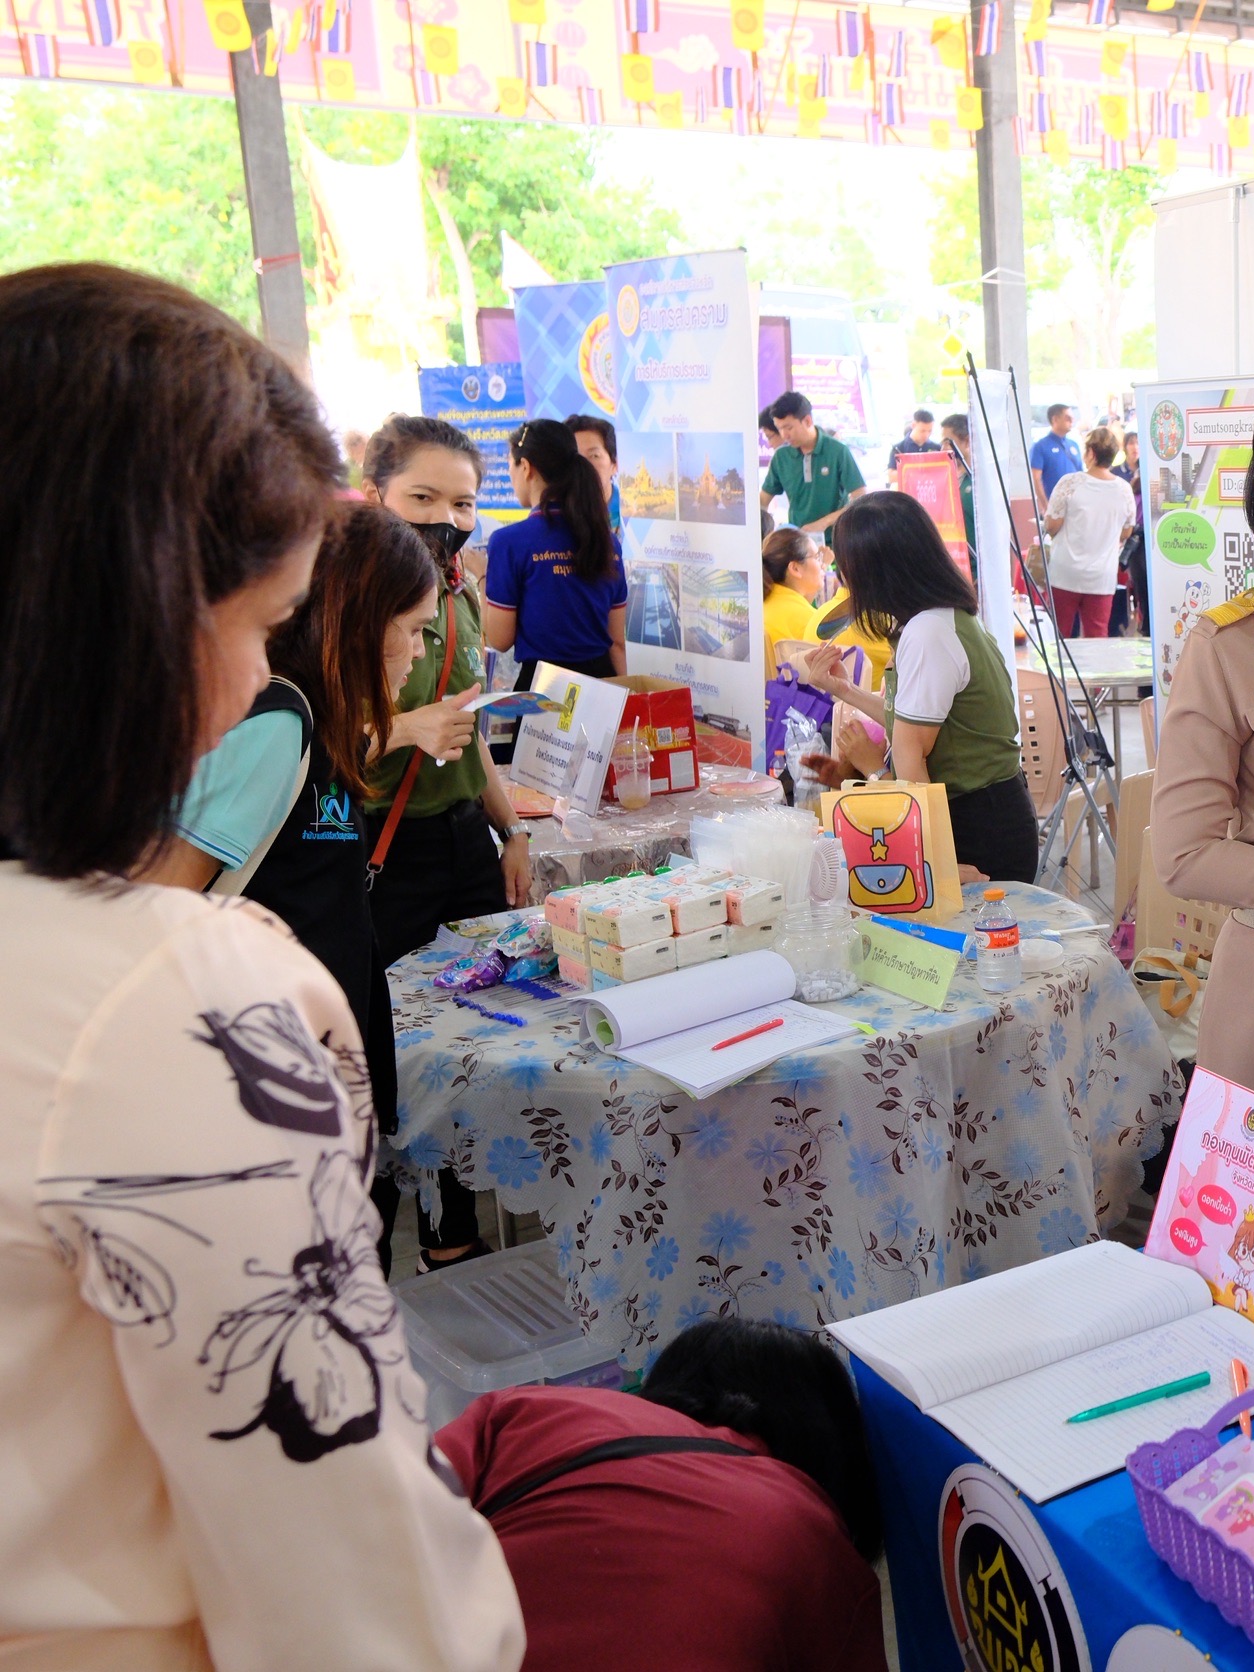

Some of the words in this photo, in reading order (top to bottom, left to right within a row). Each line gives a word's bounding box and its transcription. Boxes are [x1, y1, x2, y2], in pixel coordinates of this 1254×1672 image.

[639, 301, 728, 340] สมุทรสงคราม
[870, 948, 941, 985] ให้คำปรึกษาปัญหาที่ดิน
[1201, 1194, 1232, 1217] ดอกเบี้ยต่ำ
[1174, 1226, 1199, 1248] วงเงินสูง
